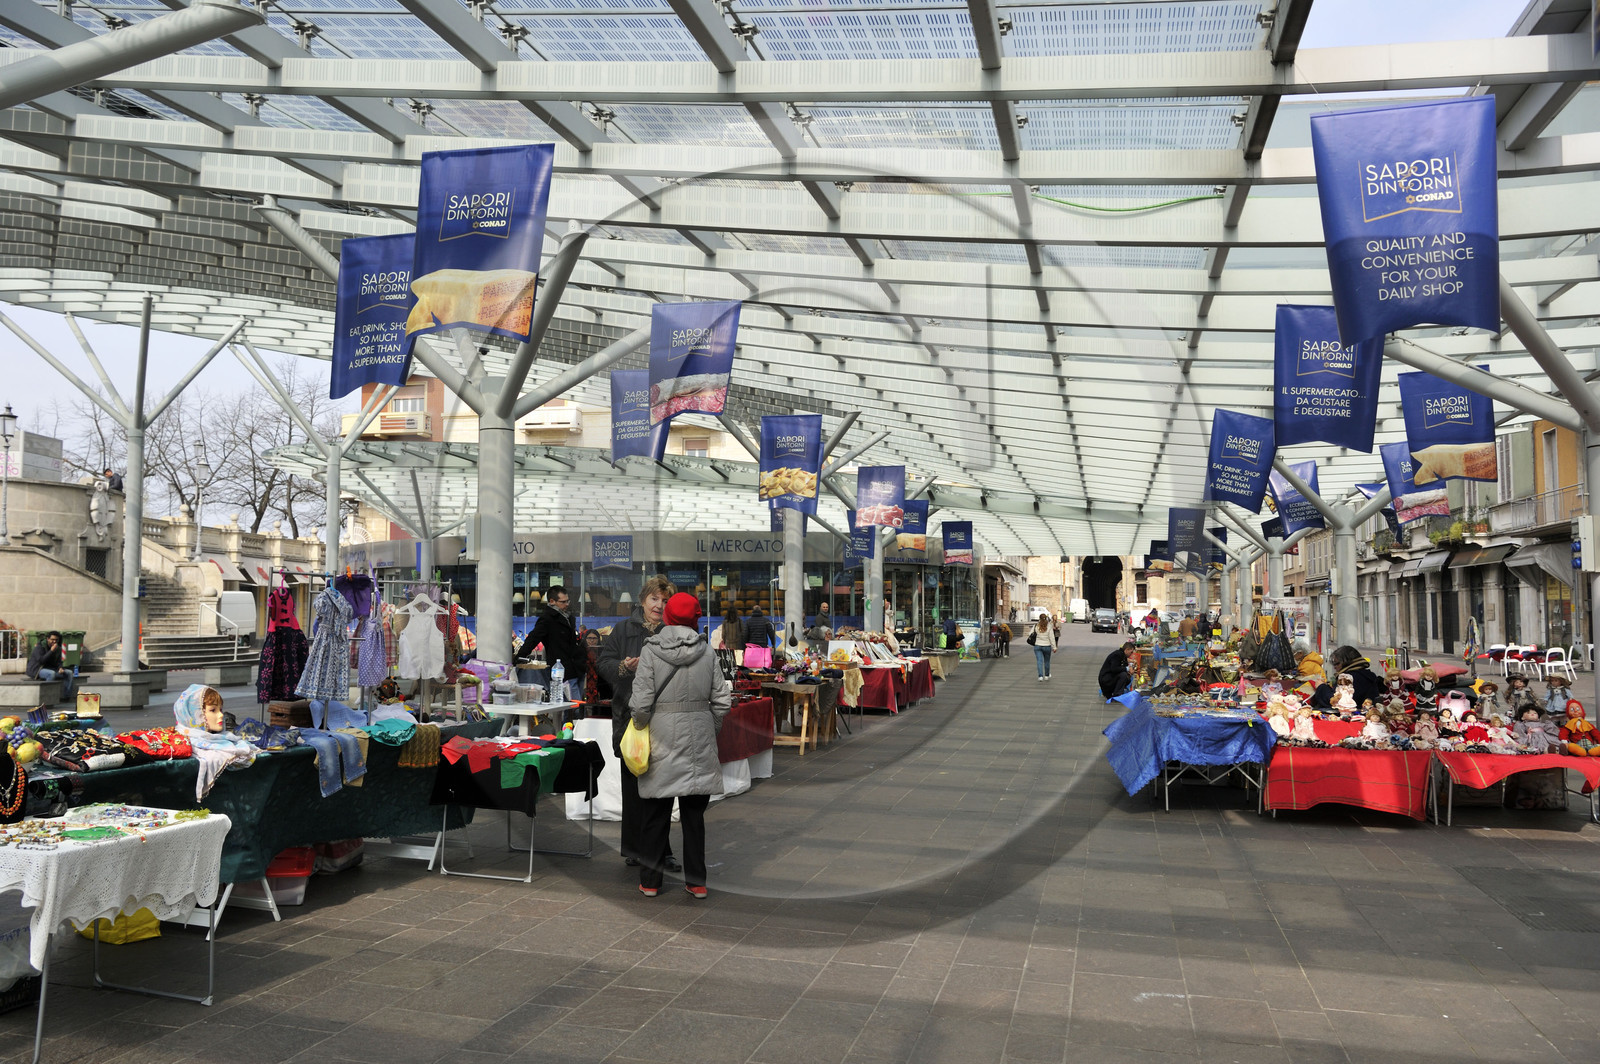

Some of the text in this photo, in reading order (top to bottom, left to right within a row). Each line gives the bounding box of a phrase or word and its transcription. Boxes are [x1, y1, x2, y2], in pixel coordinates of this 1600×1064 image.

[1366, 157, 1450, 181] SAPORI
[1367, 175, 1452, 195] DINTORNI
[449, 192, 511, 209] SAPORI
[1416, 191, 1454, 202] CONAD
[447, 206, 509, 221] DINTORNI
[479, 220, 506, 228] CONAD
[1366, 232, 1466, 253] QUALITY AND
[1361, 248, 1474, 269] CONVENIENCE
[362, 271, 410, 286] SAPORI
[1381, 265, 1457, 284] FOR YOUR
[361, 283, 408, 295] DINTORNI
[1378, 281, 1463, 301] DAILY SHOP
[350, 321, 407, 337] EAT, DRINK, SHO
[673, 328, 712, 340] SAPORI
[360, 333, 398, 345] SO MUCH
[672, 337, 712, 348] DINTORNI
[355, 344, 401, 357] MORE THAN
[1302, 351, 1353, 361] DINTORNI
[349, 355, 407, 370] A SUPERMARKET
[625, 390, 649, 398] SAPO
[1282, 386, 1366, 399] IL SUPERMERCATO...
[1296, 397, 1350, 408] DA GUSTARE
[1425, 395, 1468, 408] SAPORI
[1294, 407, 1351, 417] E DEGUSTARE
[1426, 405, 1469, 416] DINTORNI
[615, 419, 650, 428] SUPERMERCA
[1227, 435, 1260, 448] SAPORI
[1225, 443, 1259, 454] DINTORNI
[1212, 463, 1223, 471] EAT,
[1221, 471, 1249, 482] SO MUCH
[1217, 477, 1251, 490] MORE THAN
[1216, 484, 1253, 497] SUPERMARKET
[595, 541, 630, 550] SAPORI
[697, 539, 784, 553] IL MERCATO
